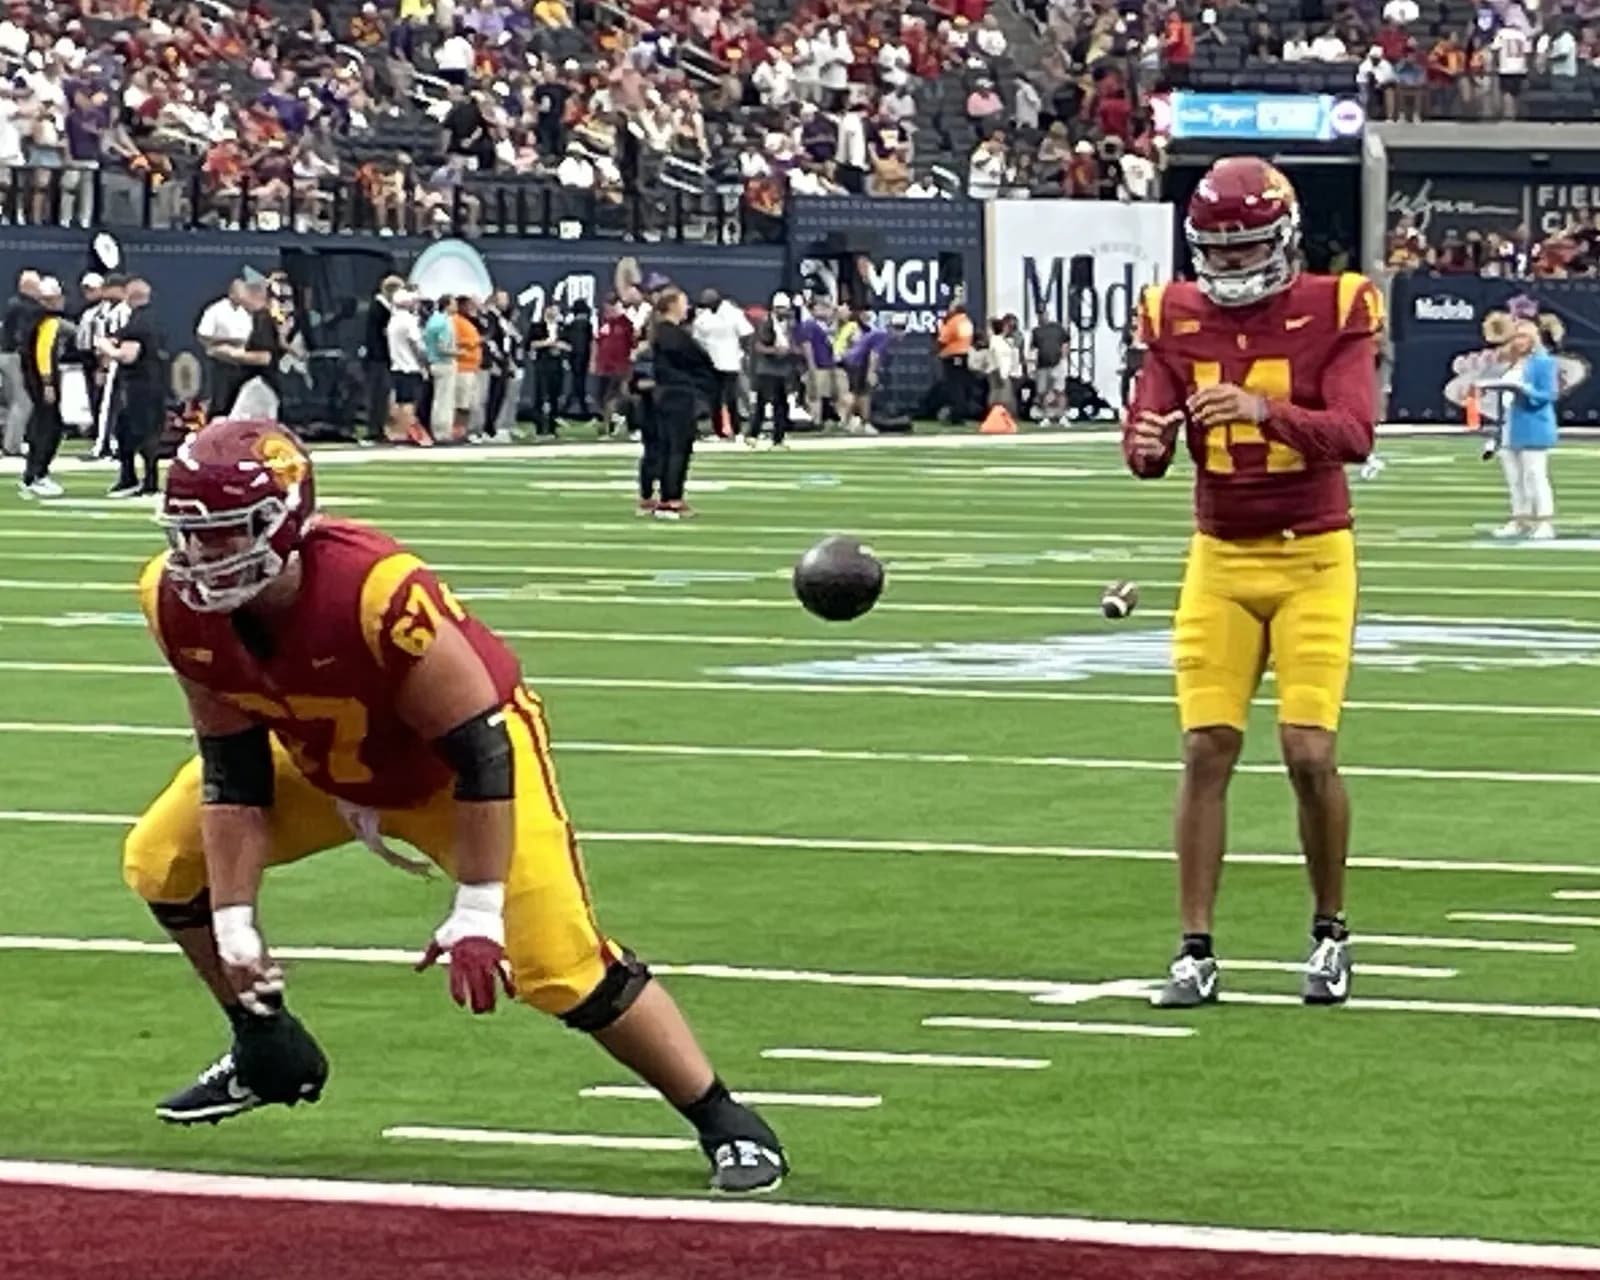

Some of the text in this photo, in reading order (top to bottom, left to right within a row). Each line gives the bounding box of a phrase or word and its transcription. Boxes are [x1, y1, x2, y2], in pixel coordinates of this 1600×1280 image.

[1537, 186, 1600, 207] FIEL
[1022, 256, 1161, 333] Mod
[1192, 358, 1306, 474] 14
[391, 581, 446, 657] 67
